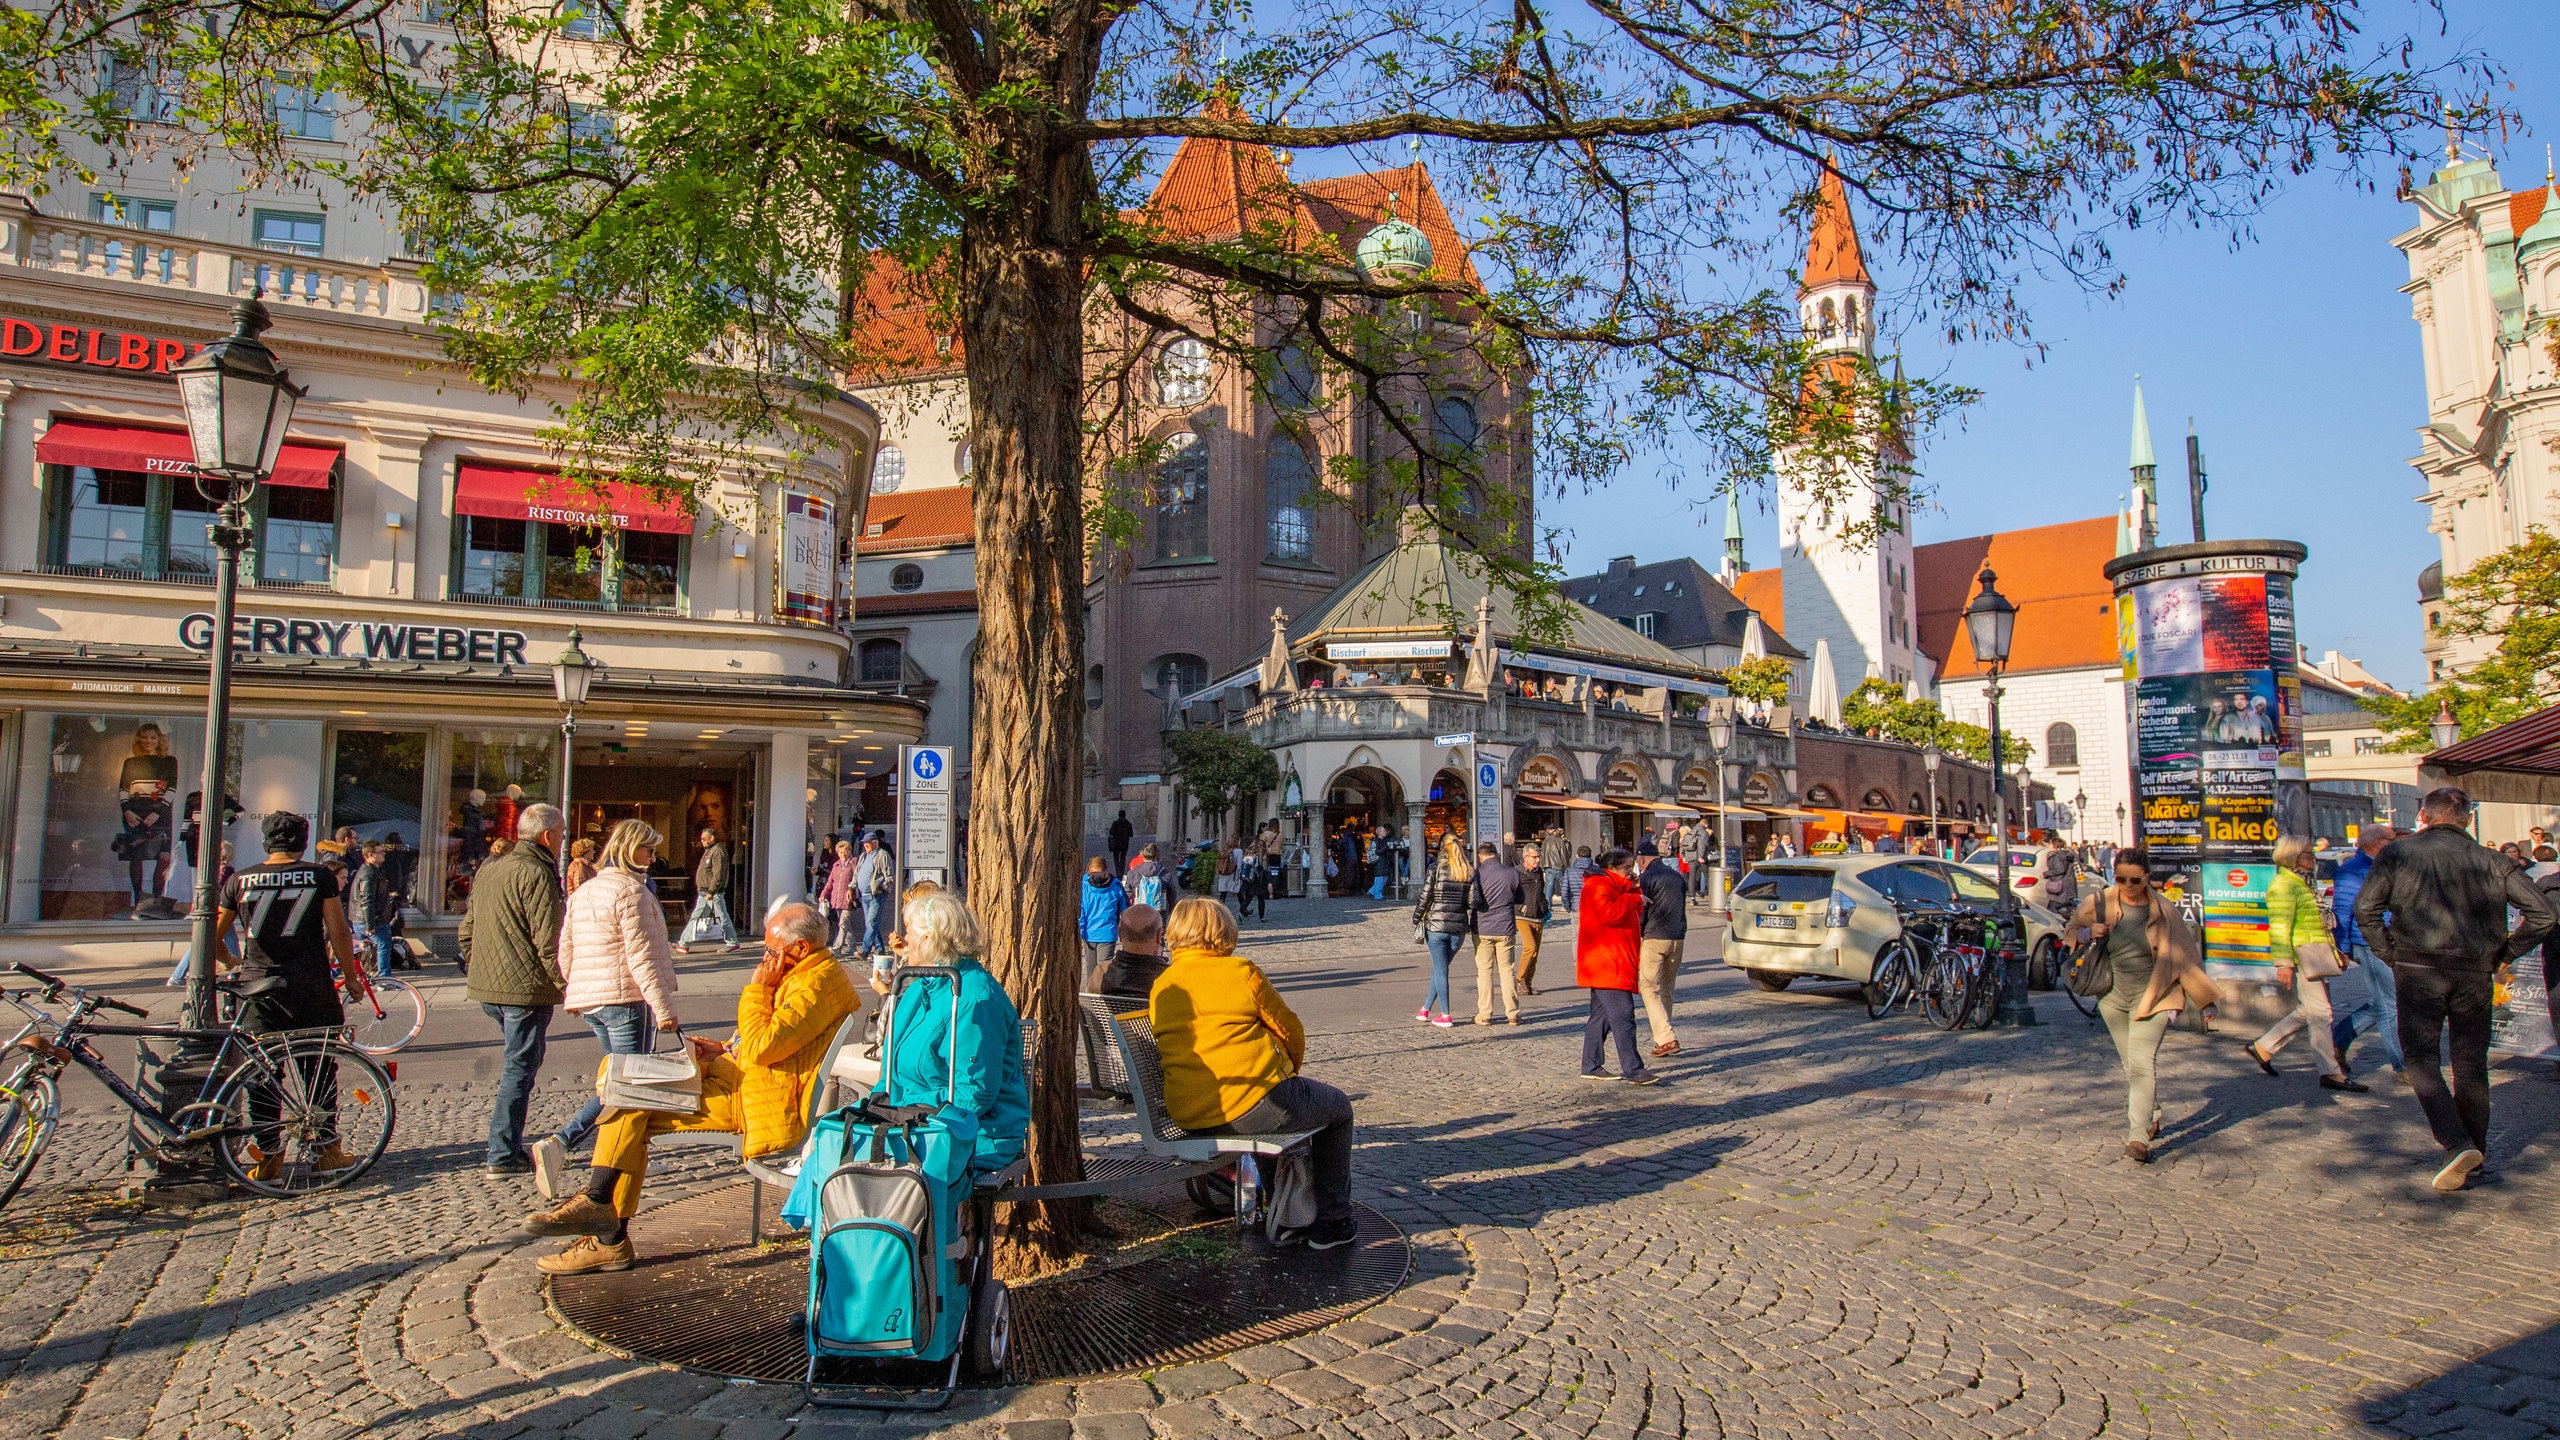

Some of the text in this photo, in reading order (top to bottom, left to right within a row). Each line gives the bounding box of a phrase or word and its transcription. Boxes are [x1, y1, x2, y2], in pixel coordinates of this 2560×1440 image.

[1, 318, 206, 374] DELBR
[2124, 565, 2166, 583] SZENE
[2200, 557, 2266, 572] KULTUR
[178, 613, 529, 666] GERRY WEBER
[2141, 633, 2156, 642] DUE
[2157, 629, 2196, 639] FOSCARI
[1331, 648, 1367, 658] Rischart
[1411, 646, 1448, 656] Rischart
[72, 682, 181, 694] AUTOMATISCHE MARKISE
[2138, 696, 2167, 707] London
[2138, 704, 2197, 717] Philharmonic
[2139, 716, 2178, 727] Orchestra
[1437, 735, 1468, 745] Petersplatz
[1524, 771, 1552, 784] Rischart
[916, 781, 939, 789] ZONE
[2203, 784, 2230, 795] 14.12.
[2158, 796, 2182, 805] Nikolai
[2205, 797, 2218, 805] Die
[2142, 801, 2200, 819] Tokarev
[2234, 805, 2248, 813] den
[2162, 820, 2201, 828] Philharmonic
[2204, 816, 2278, 841] Take 6
[239, 871, 316, 889] TROOPER
[2208, 889, 2267, 899] NOVEMBER
[240, 887, 317, 938] 77
[1778, 917, 1795, 926] 2302
